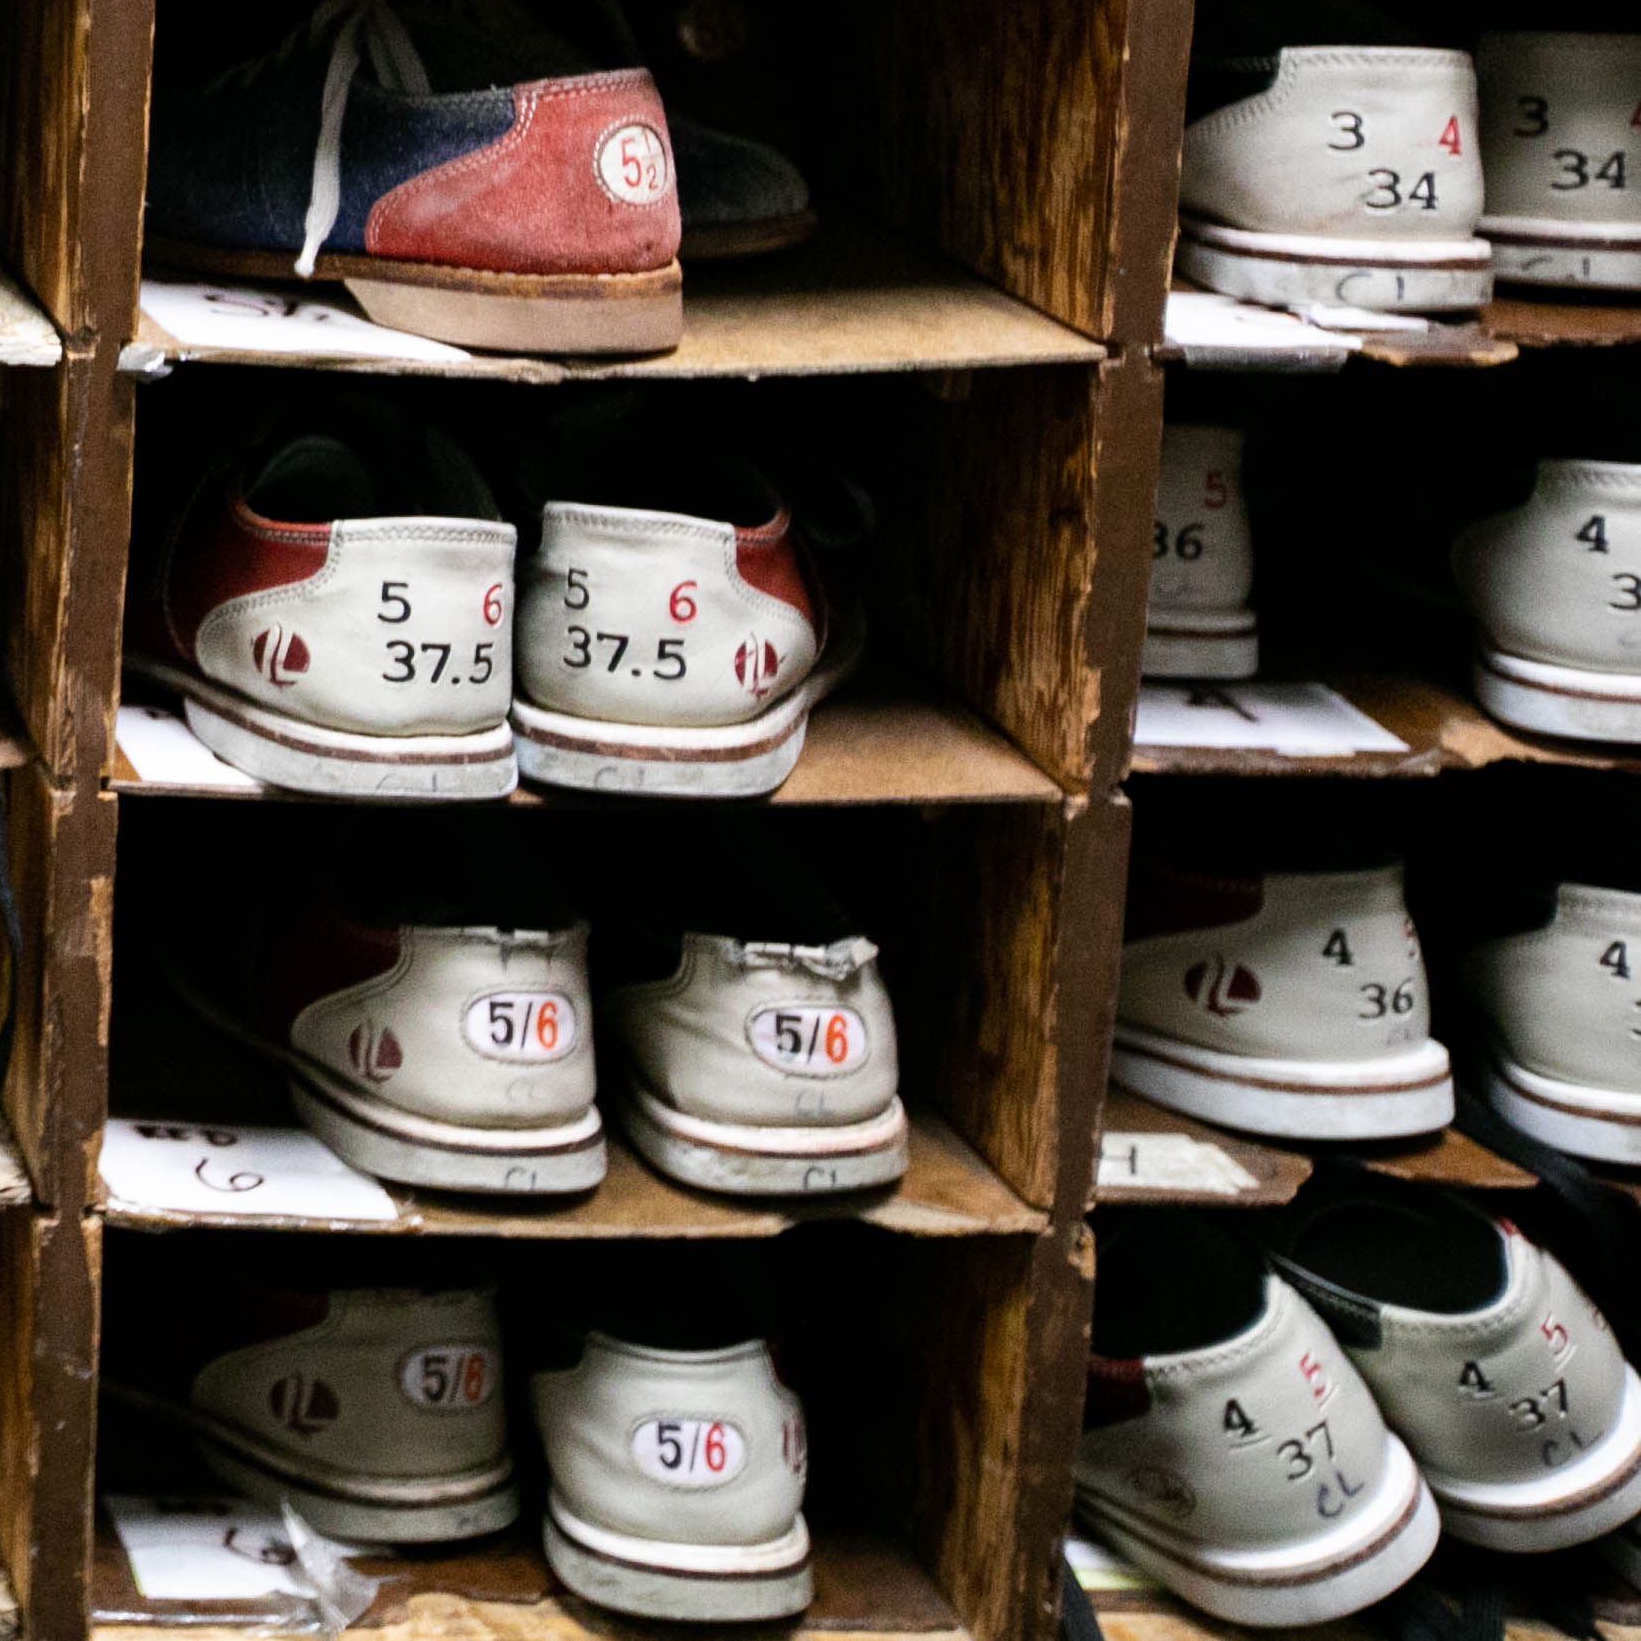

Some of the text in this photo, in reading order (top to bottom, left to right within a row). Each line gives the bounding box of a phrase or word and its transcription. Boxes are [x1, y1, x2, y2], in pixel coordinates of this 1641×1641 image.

[1328, 111, 1461, 155] 3 4
[1516, 97, 1548, 136] 3
[1365, 169, 1437, 210] 34
[1551, 150, 1626, 190] 34
[1204, 472, 1227, 509] 5
[1577, 516, 1608, 553] 4
[378, 582, 503, 625] 5 6
[564, 569, 698, 623] 5 6
[383, 642, 493, 684] 37.5
[564, 627, 689, 681] 37.5
[1323, 930, 1352, 965] 4
[1600, 941, 1629, 978] 4
[1360, 978, 1413, 1019] 36
[488, 1001, 559, 1051] 5/6
[775, 1013, 849, 1066] 5/6
[1460, 1314, 1570, 1394] 4 5
[423, 1354, 486, 1401] 5/6
[1224, 1354, 1327, 1438] 4 5
[1510, 1379, 1570, 1435] 37
[656, 1422, 725, 1471] 5/6
[1278, 1422, 1337, 1480] 37
